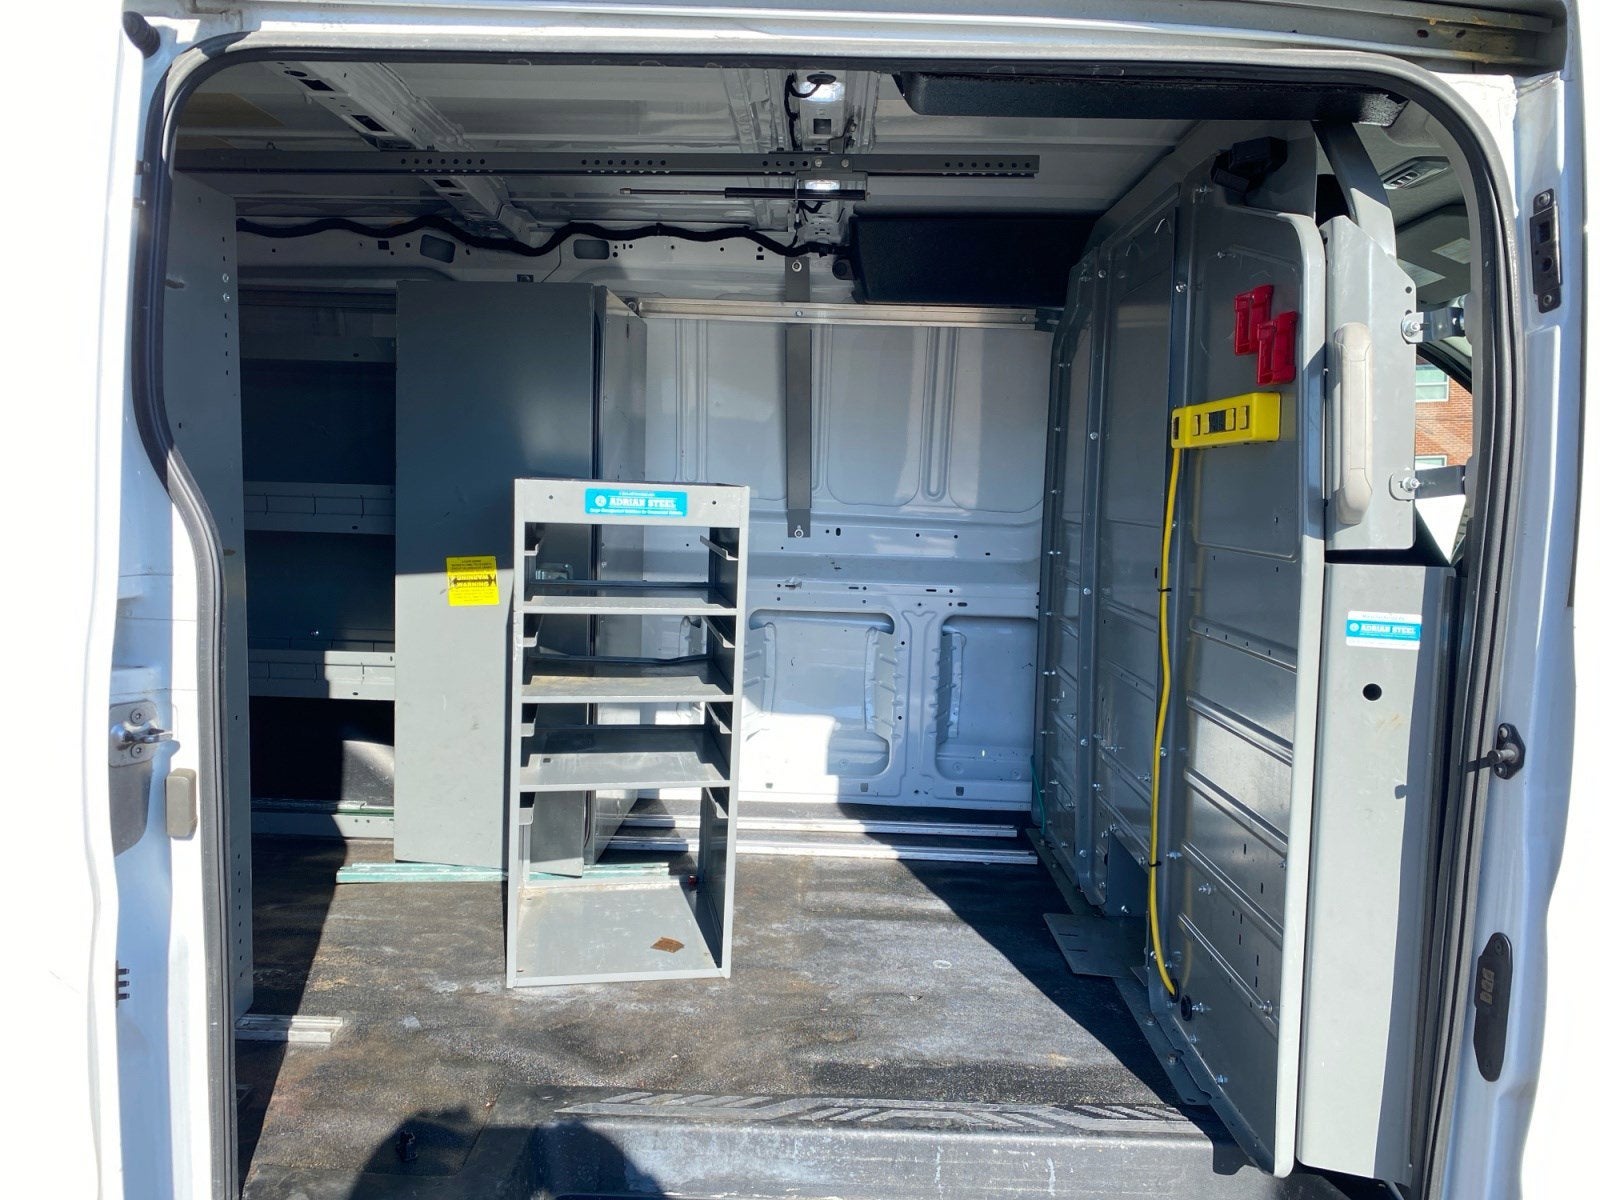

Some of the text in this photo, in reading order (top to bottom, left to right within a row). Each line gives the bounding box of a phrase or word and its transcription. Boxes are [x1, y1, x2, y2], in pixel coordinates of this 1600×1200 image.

[609, 497, 677, 508] ADRIAN STEEL
[1361, 624, 1416, 635] ADRIAN STEEL
